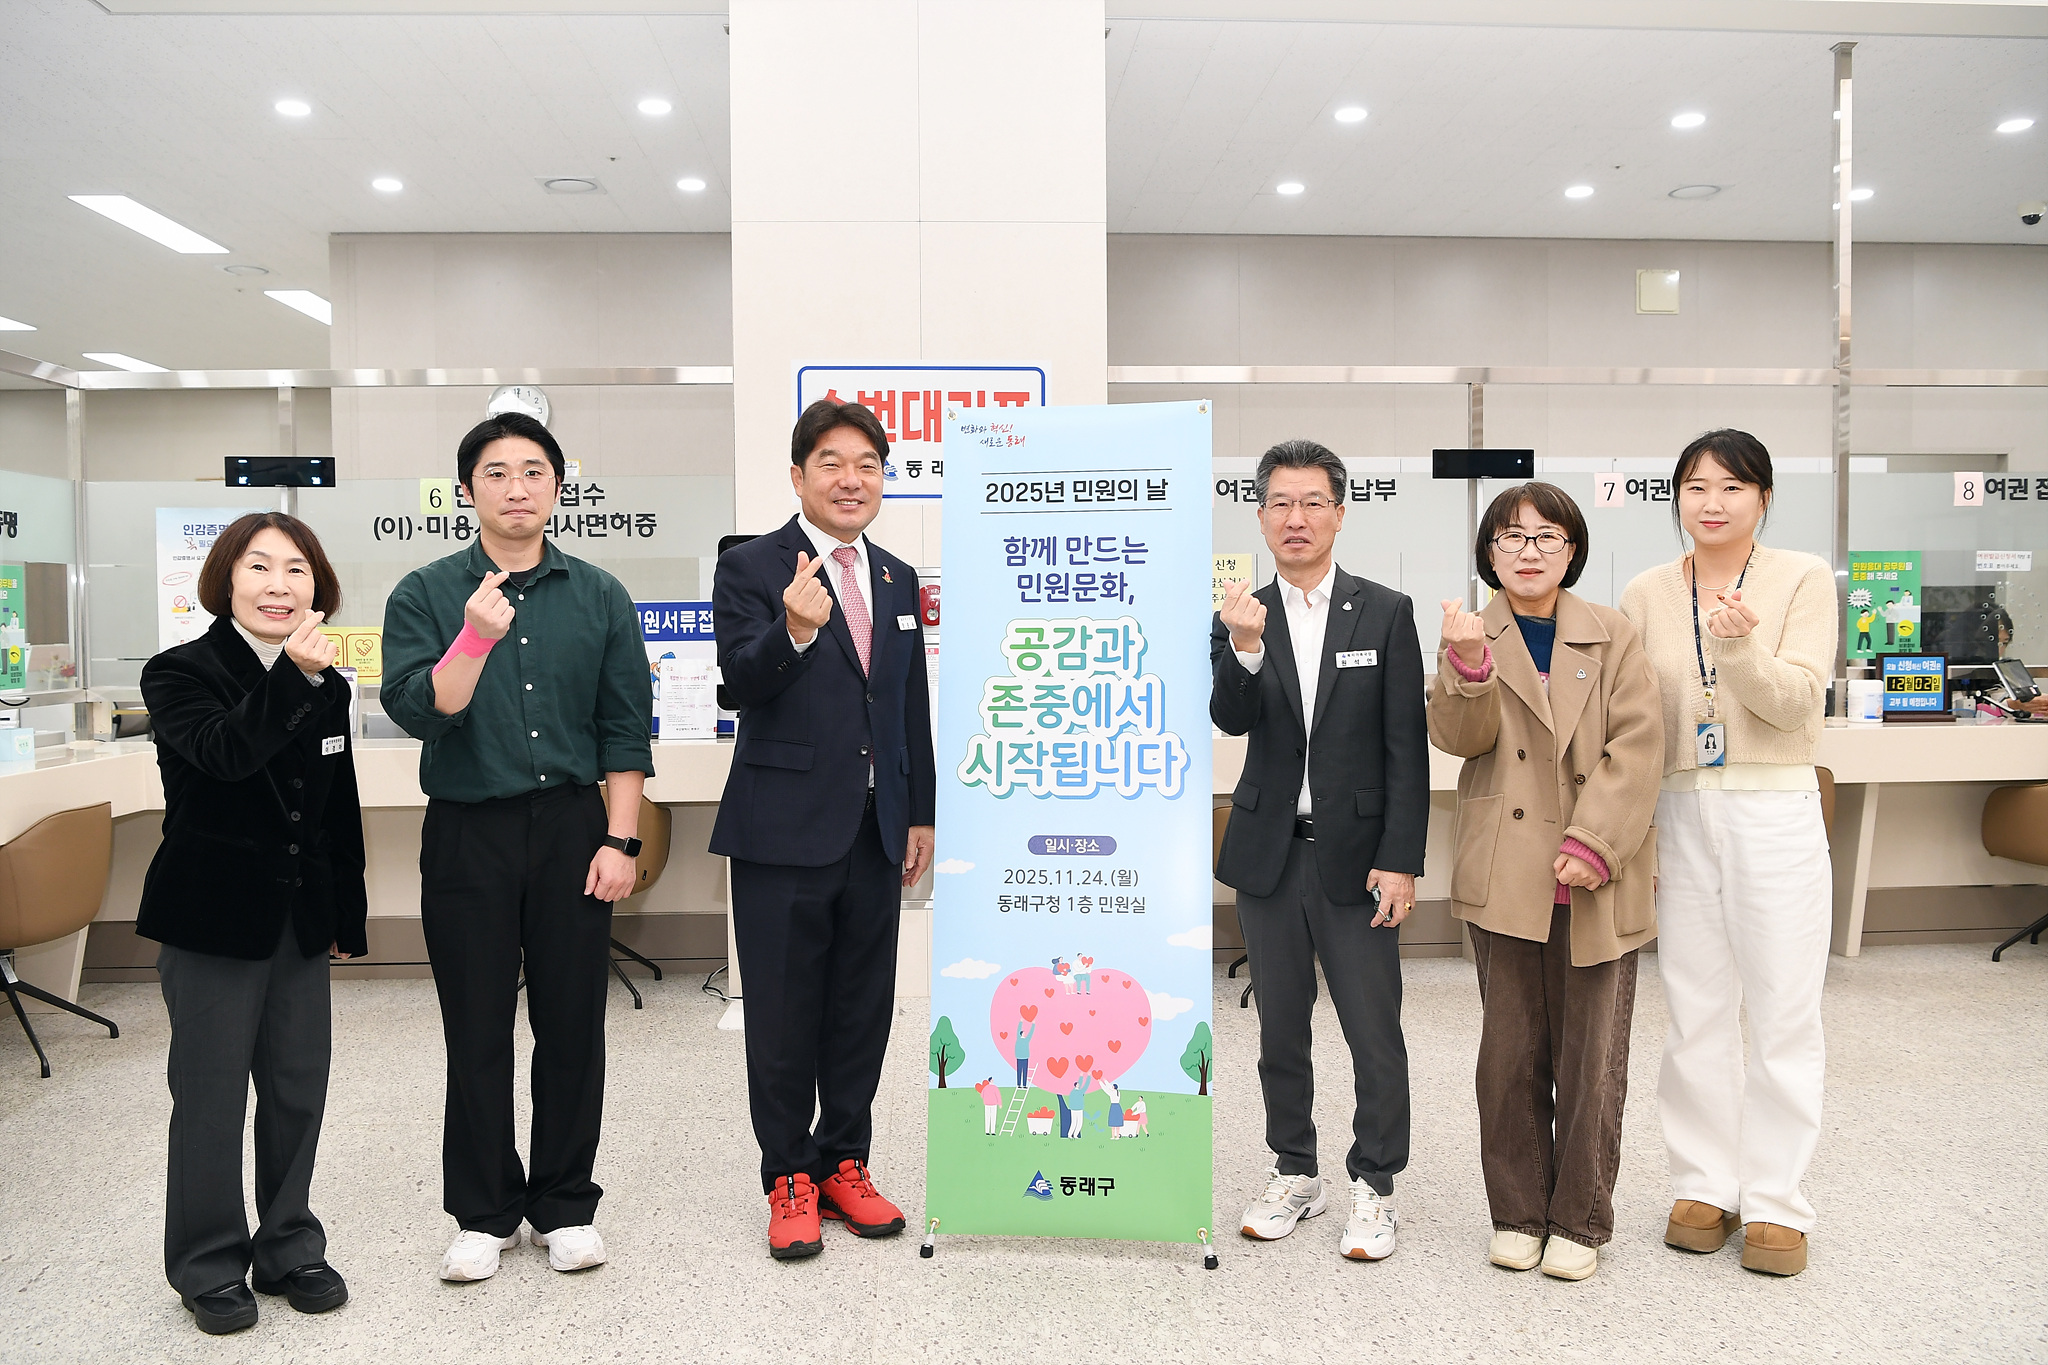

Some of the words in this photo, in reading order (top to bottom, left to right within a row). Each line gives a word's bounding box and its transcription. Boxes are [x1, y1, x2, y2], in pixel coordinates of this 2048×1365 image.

[961, 424, 987, 434] 변화와
[990, 423, 1013, 434] 혁신!
[980, 437, 1003, 448] 새로운
[1006, 435, 1026, 448] 동래
[429, 488, 442, 508] 6
[986, 481, 1065, 503] 2025년
[1073, 479, 1138, 502] 민원의
[1147, 478, 1169, 501] 날
[1351, 478, 1397, 502] 납부
[1603, 482, 1616, 501] 7
[1963, 481, 1975, 500] 8
[1985, 478, 2028, 500] 여권
[1003, 536, 1057, 566] 함께
[1066, 535, 1149, 566] 만드는
[1876, 572, 1898, 581] 주세요
[1017, 572, 1134, 605] 민원문화,
[1009, 625, 1136, 671] 공감과
[987, 682, 1153, 729] 존중에서
[966, 741, 1179, 788] 시작됩니다
[1045, 838, 1100, 854] 일시·장소
[1004, 869, 1139, 887] 2025.11.24.(월)
[997, 895, 1061, 914] 동래구청
[1067, 895, 1094, 914] 1층
[1099, 896, 1146, 914] 민원실
[1059, 1176, 1116, 1197] 동래구
